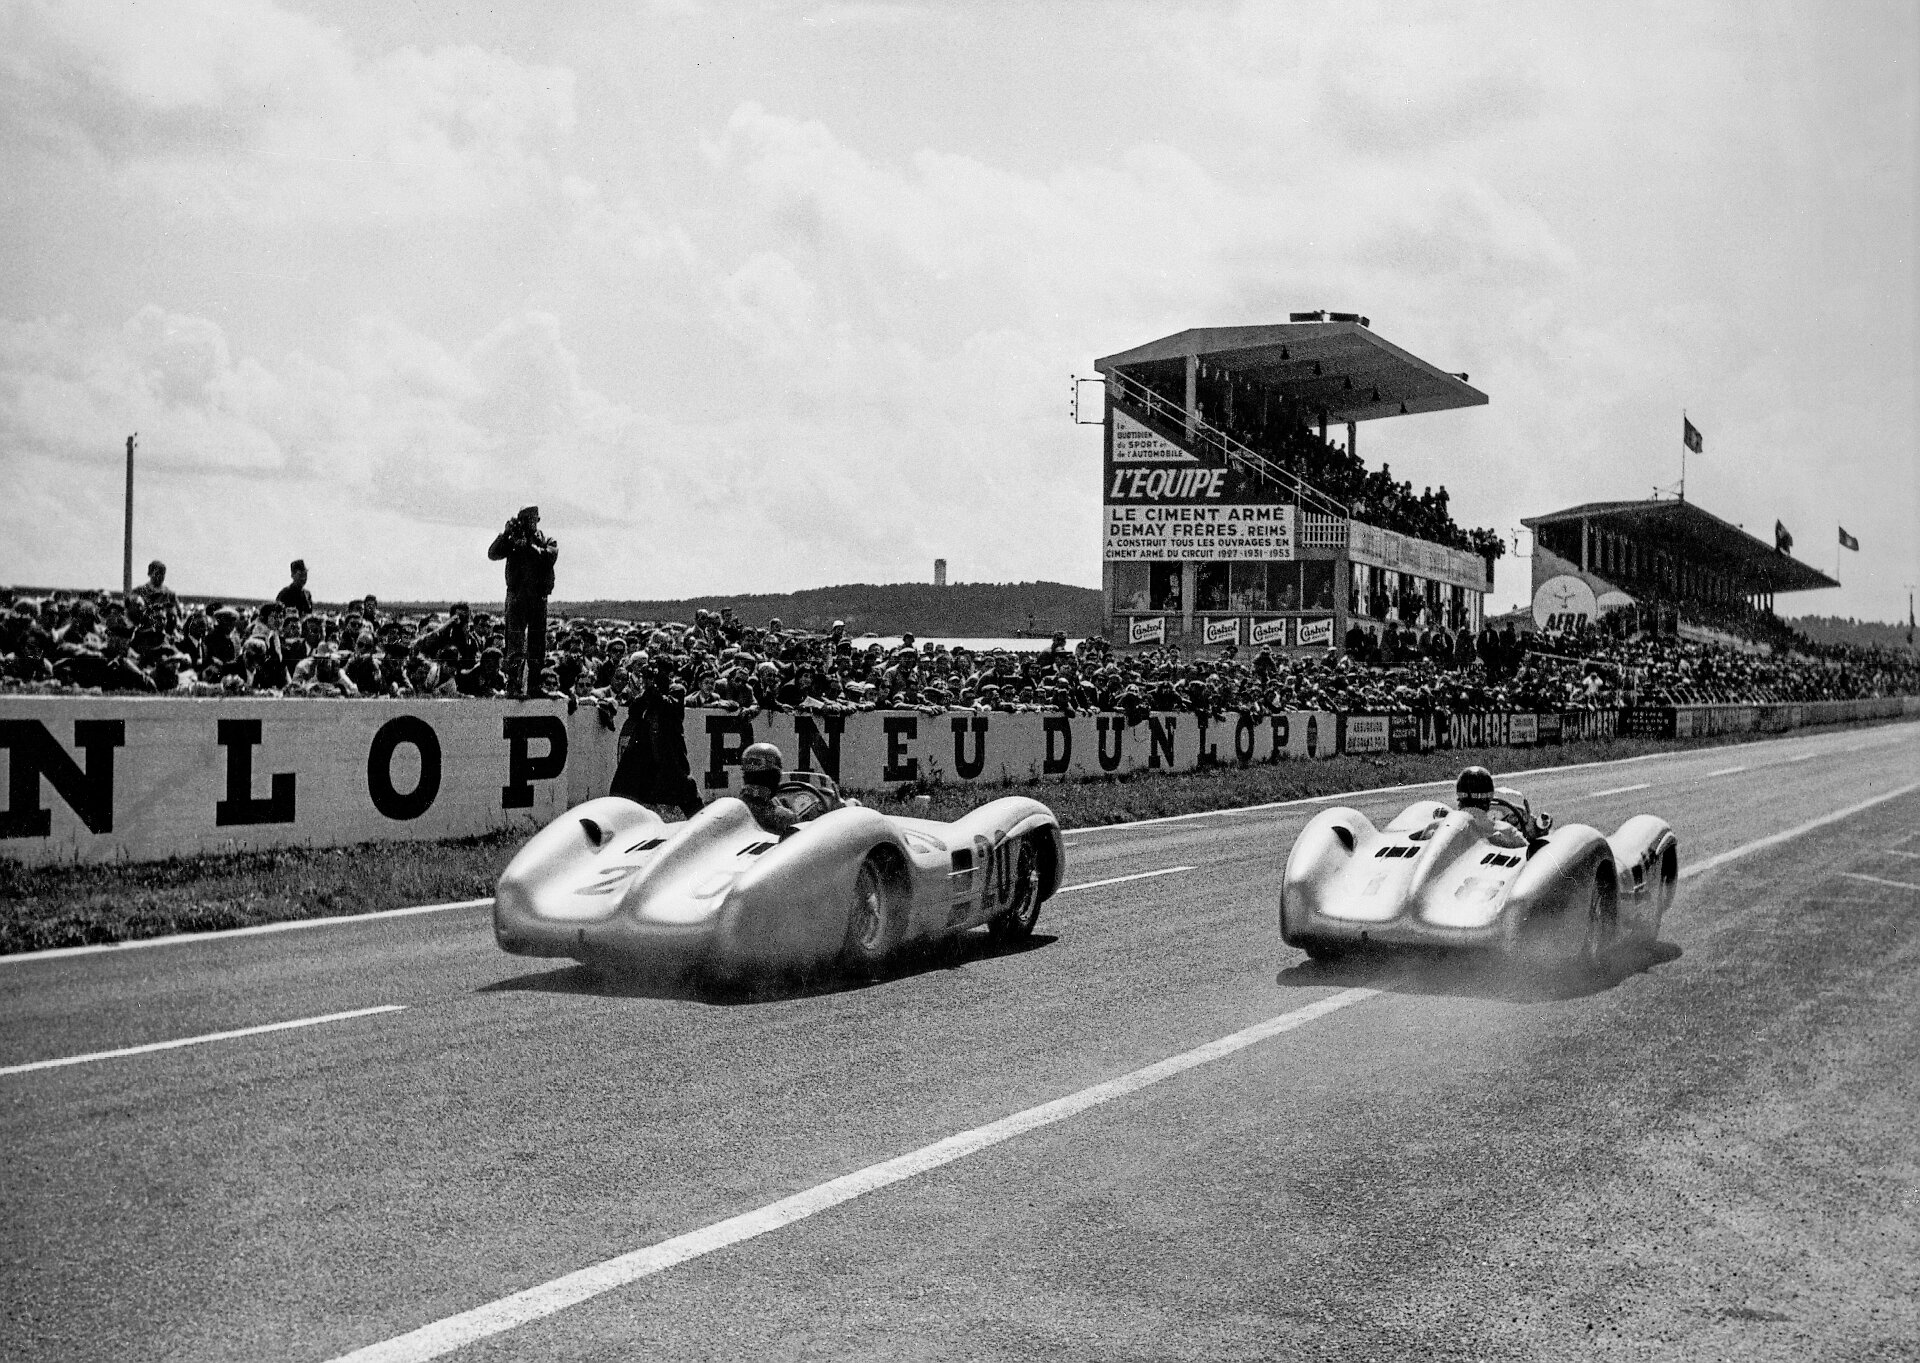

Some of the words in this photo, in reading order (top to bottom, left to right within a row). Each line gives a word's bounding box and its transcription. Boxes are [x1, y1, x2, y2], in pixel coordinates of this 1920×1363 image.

[1128, 440, 1158, 449] SPORT
[1112, 508, 1136, 521] LE
[1145, 508, 1220, 521] CIMENT
[1110, 523, 1166, 537] DEMAY
[1247, 525, 1287, 537] REIMS
[1117, 539, 1167, 547] CONSTRUIT
[1171, 539, 1194, 547] TOUS
[1197, 538, 1215, 547] LES
[1217, 538, 1271, 547] OUVRAGES
[1275, 538, 1289, 547] EN
[1105, 549, 1137, 558] CIMENT
[1167, 549, 1179, 558] DU
[1181, 549, 1213, 558] CIRCUIT
[1132, 620, 1163, 640] Castrol
[1207, 621, 1238, 641] Castrol
[1253, 621, 1284, 641] Castrol
[1300, 621, 1331, 641] Castrol
[1420, 714, 1437, 750] LA
[1442, 713, 1508, 750] ONCIERE
[1043, 714, 1290, 774] DUNLOP
